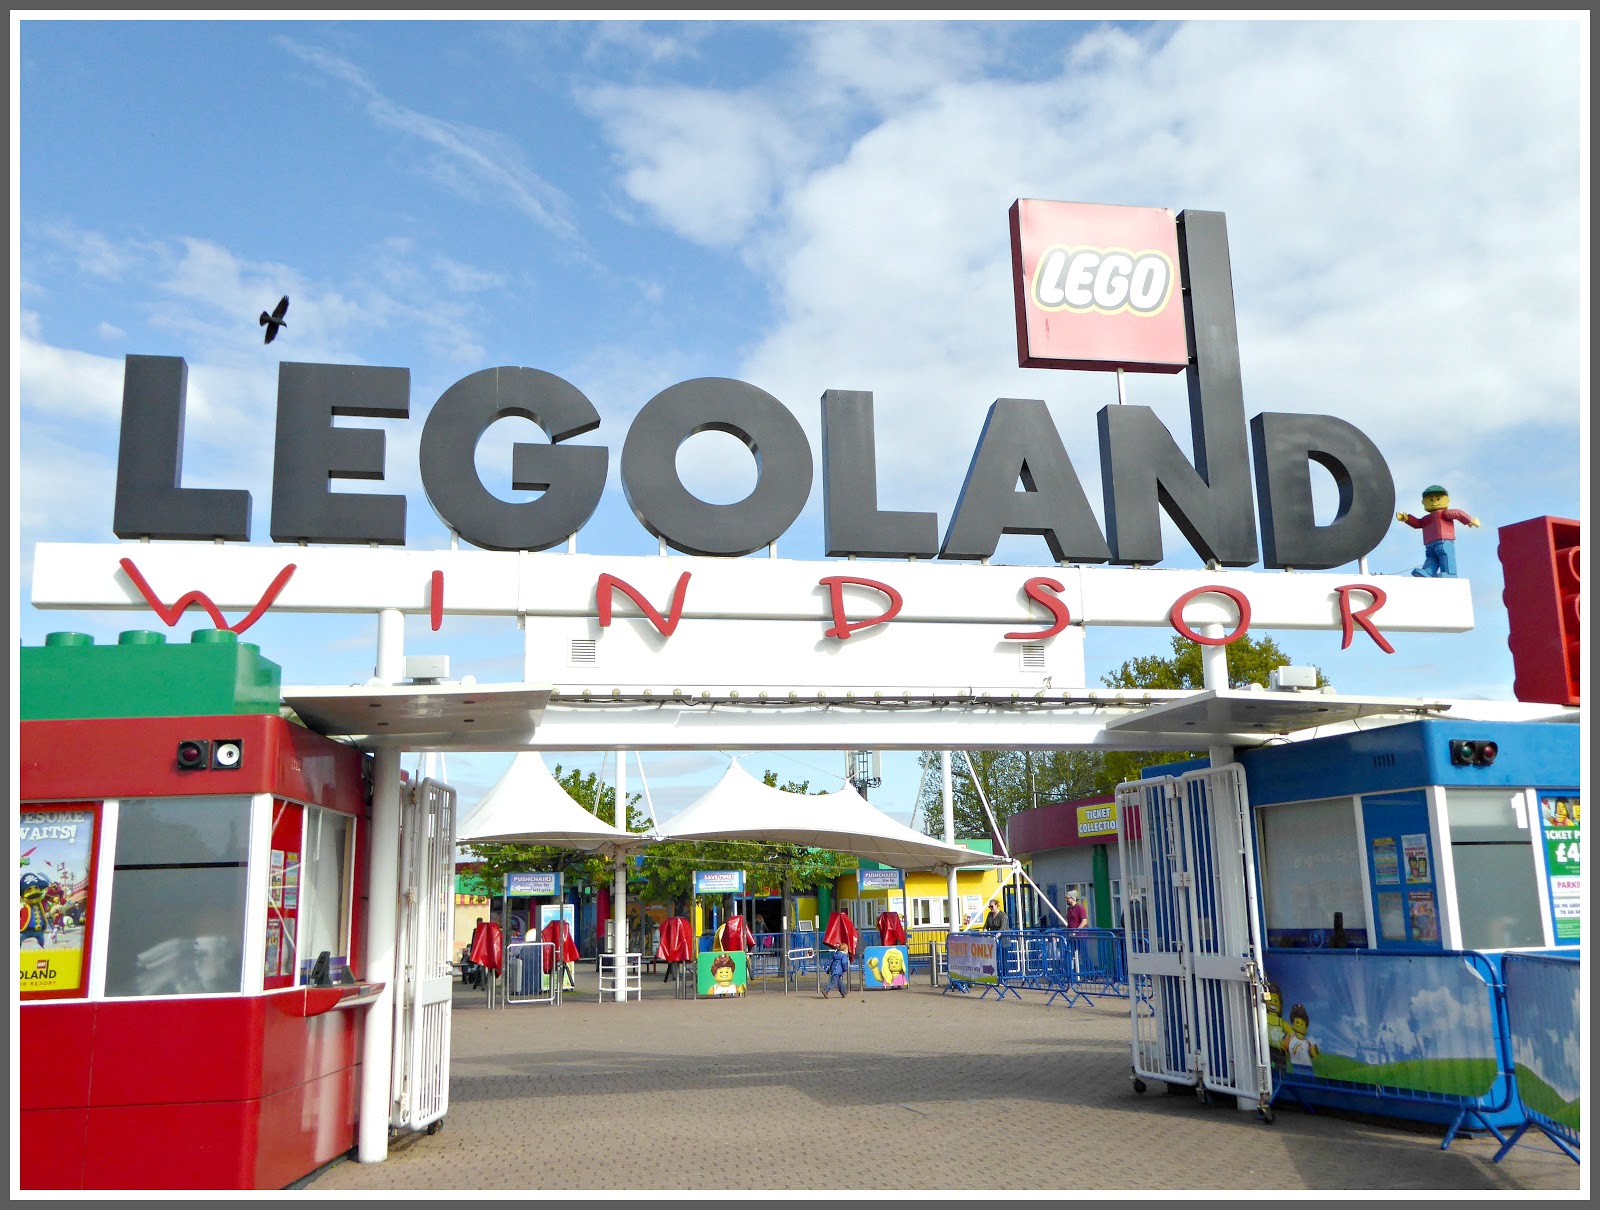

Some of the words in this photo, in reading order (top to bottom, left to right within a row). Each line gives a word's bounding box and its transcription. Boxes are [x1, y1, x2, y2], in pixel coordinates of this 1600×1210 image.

[1035, 247, 1172, 314] LEGO
[113, 210, 1395, 571] LEGOLAND
[119, 556, 1396, 655] WINDSOR
[20, 811, 85, 824] ESOME
[1086, 808, 1111, 820] TICKET
[1510, 792, 1529, 829] 1
[1555, 842, 1580, 863] £4
[950, 941, 968, 957] EXIT
[971, 943, 994, 960] ONLY
